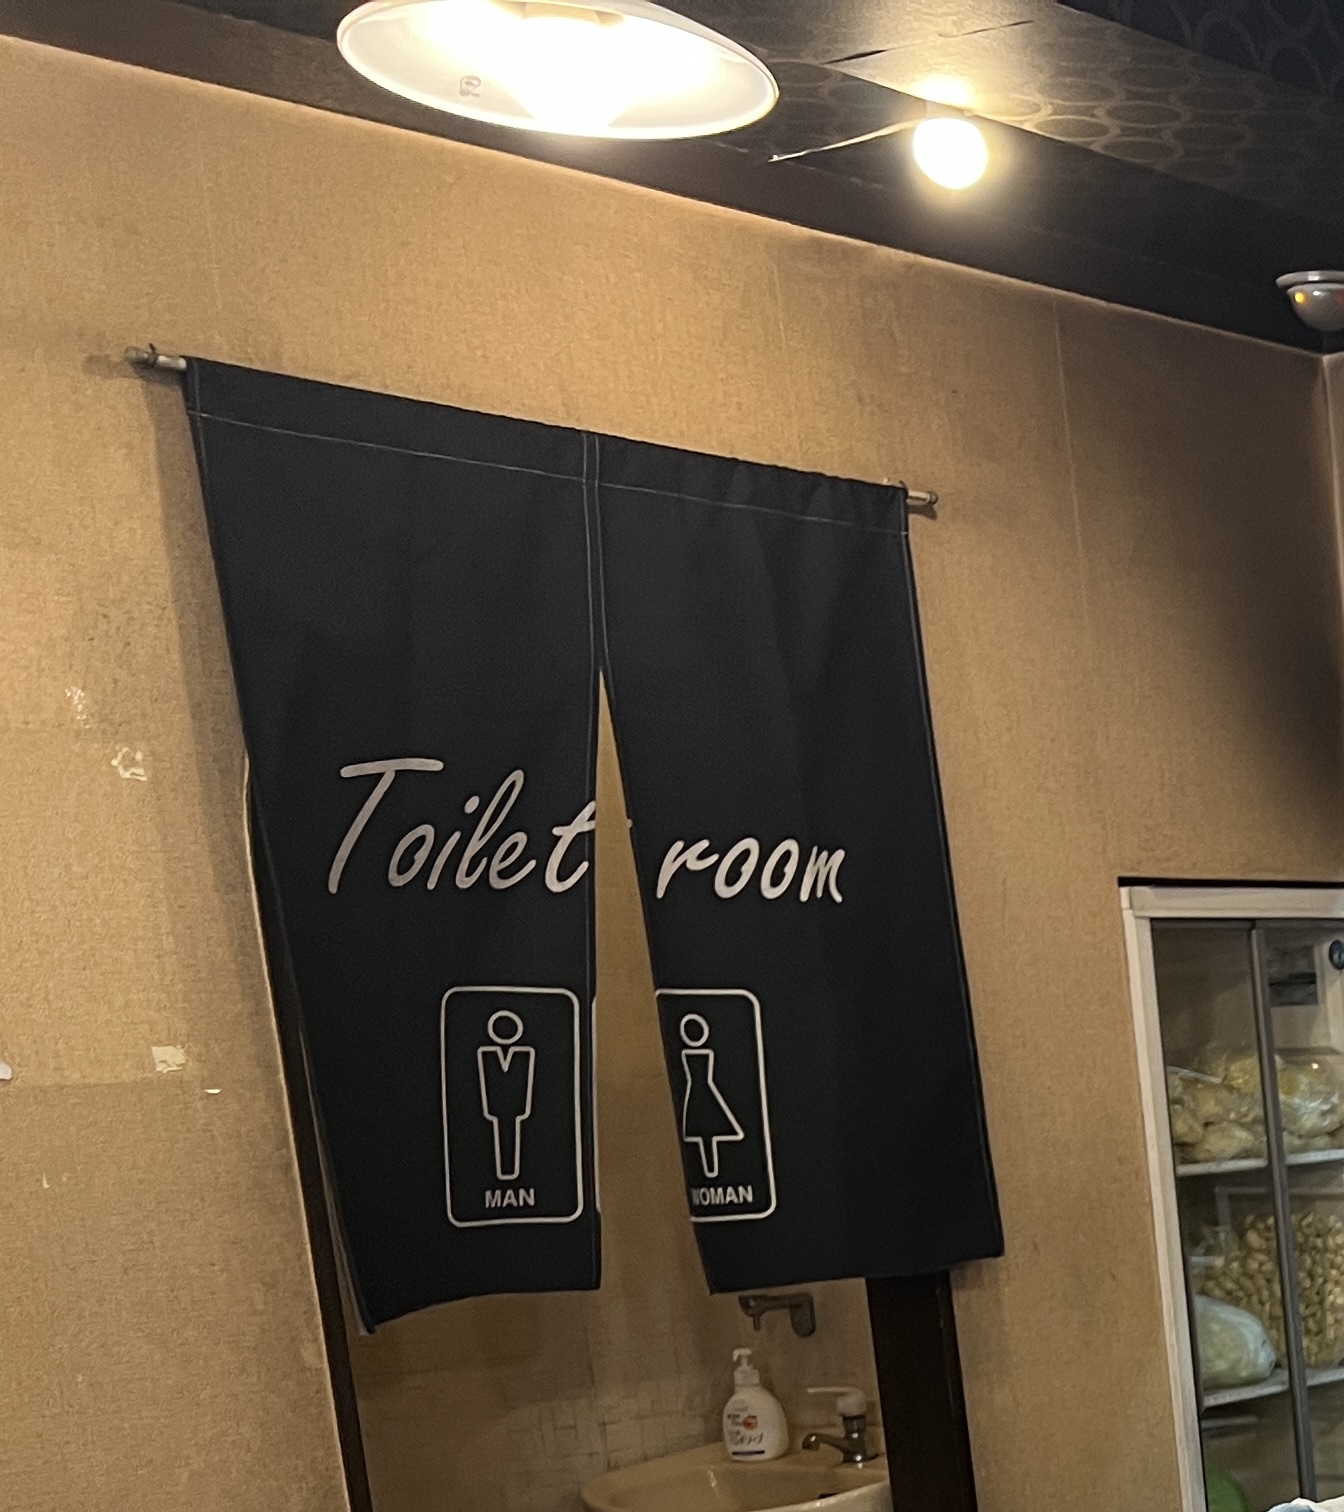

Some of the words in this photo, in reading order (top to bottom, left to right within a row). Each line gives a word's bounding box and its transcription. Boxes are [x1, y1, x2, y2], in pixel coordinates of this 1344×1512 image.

[327, 757, 598, 896] Toilet
[656, 835, 847, 906] room
[485, 1187, 536, 1211] MAN
